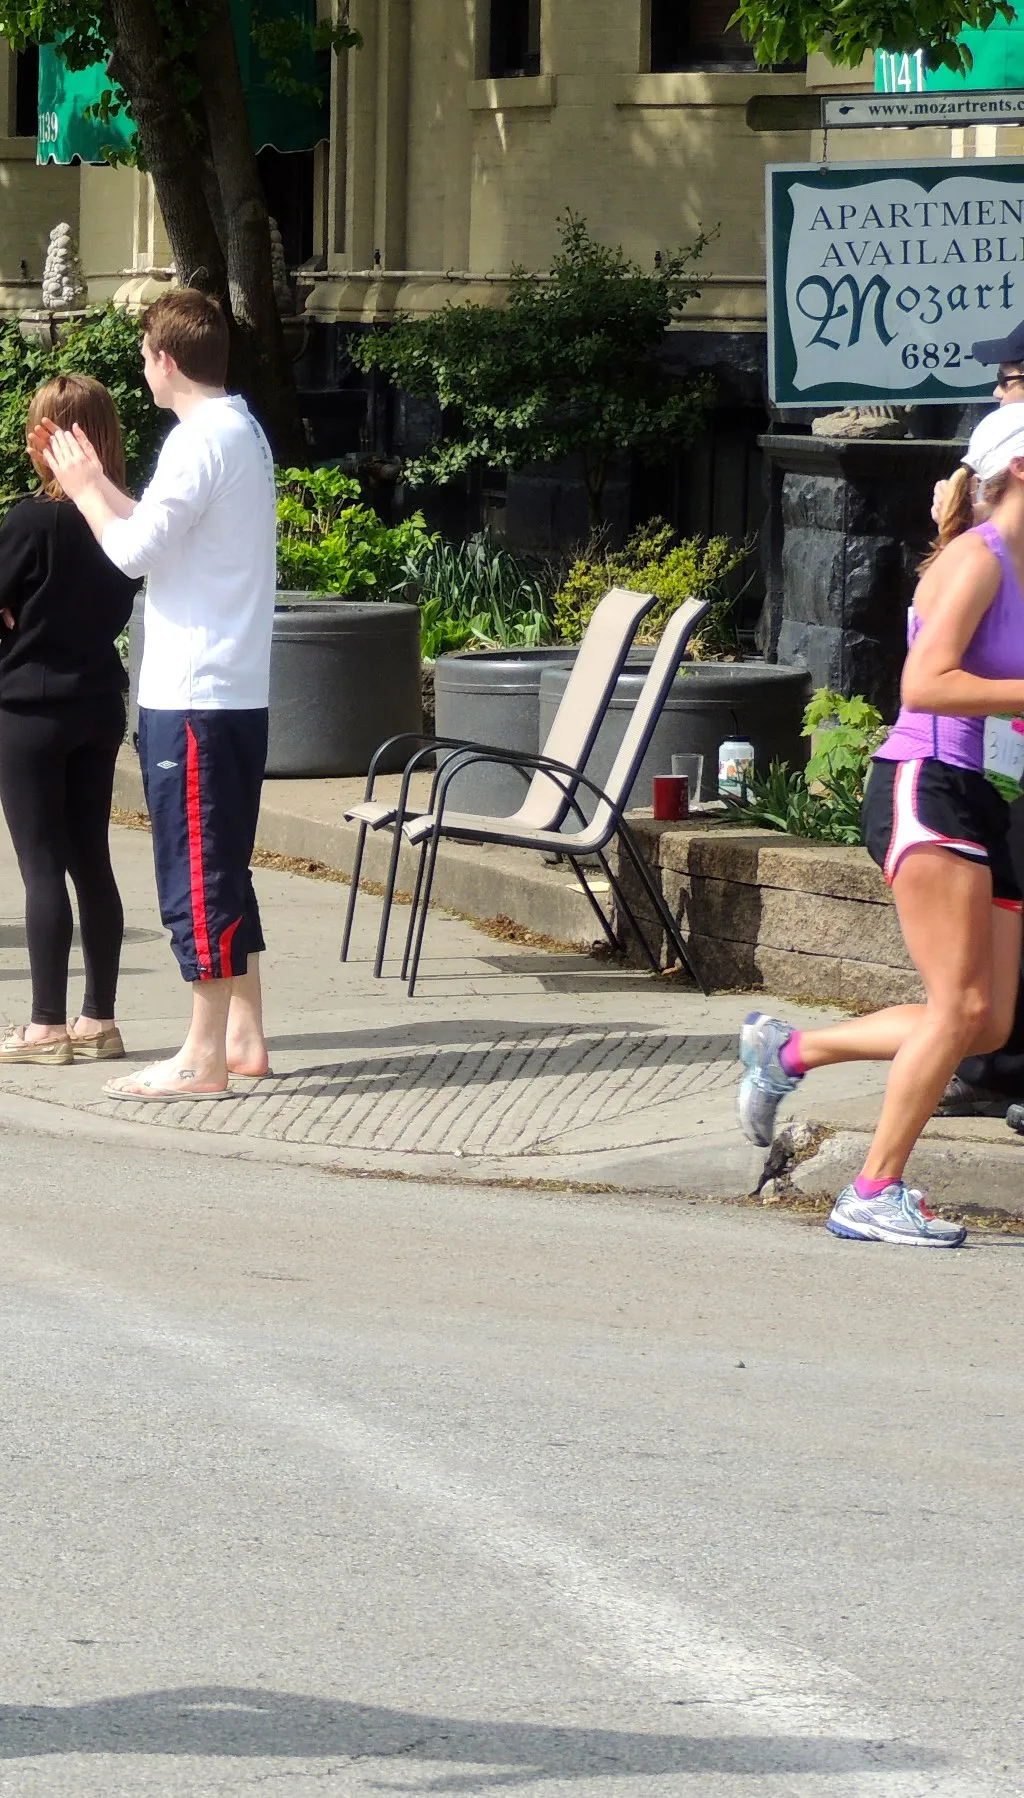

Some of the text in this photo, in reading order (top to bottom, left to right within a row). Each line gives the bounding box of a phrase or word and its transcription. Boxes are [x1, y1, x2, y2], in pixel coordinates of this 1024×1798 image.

[880, 48, 924, 93] 1141
[808, 200, 1024, 230] APARTMEN
[796, 271, 1014, 350] Mozart
[901, 342, 988, 369] 682-
